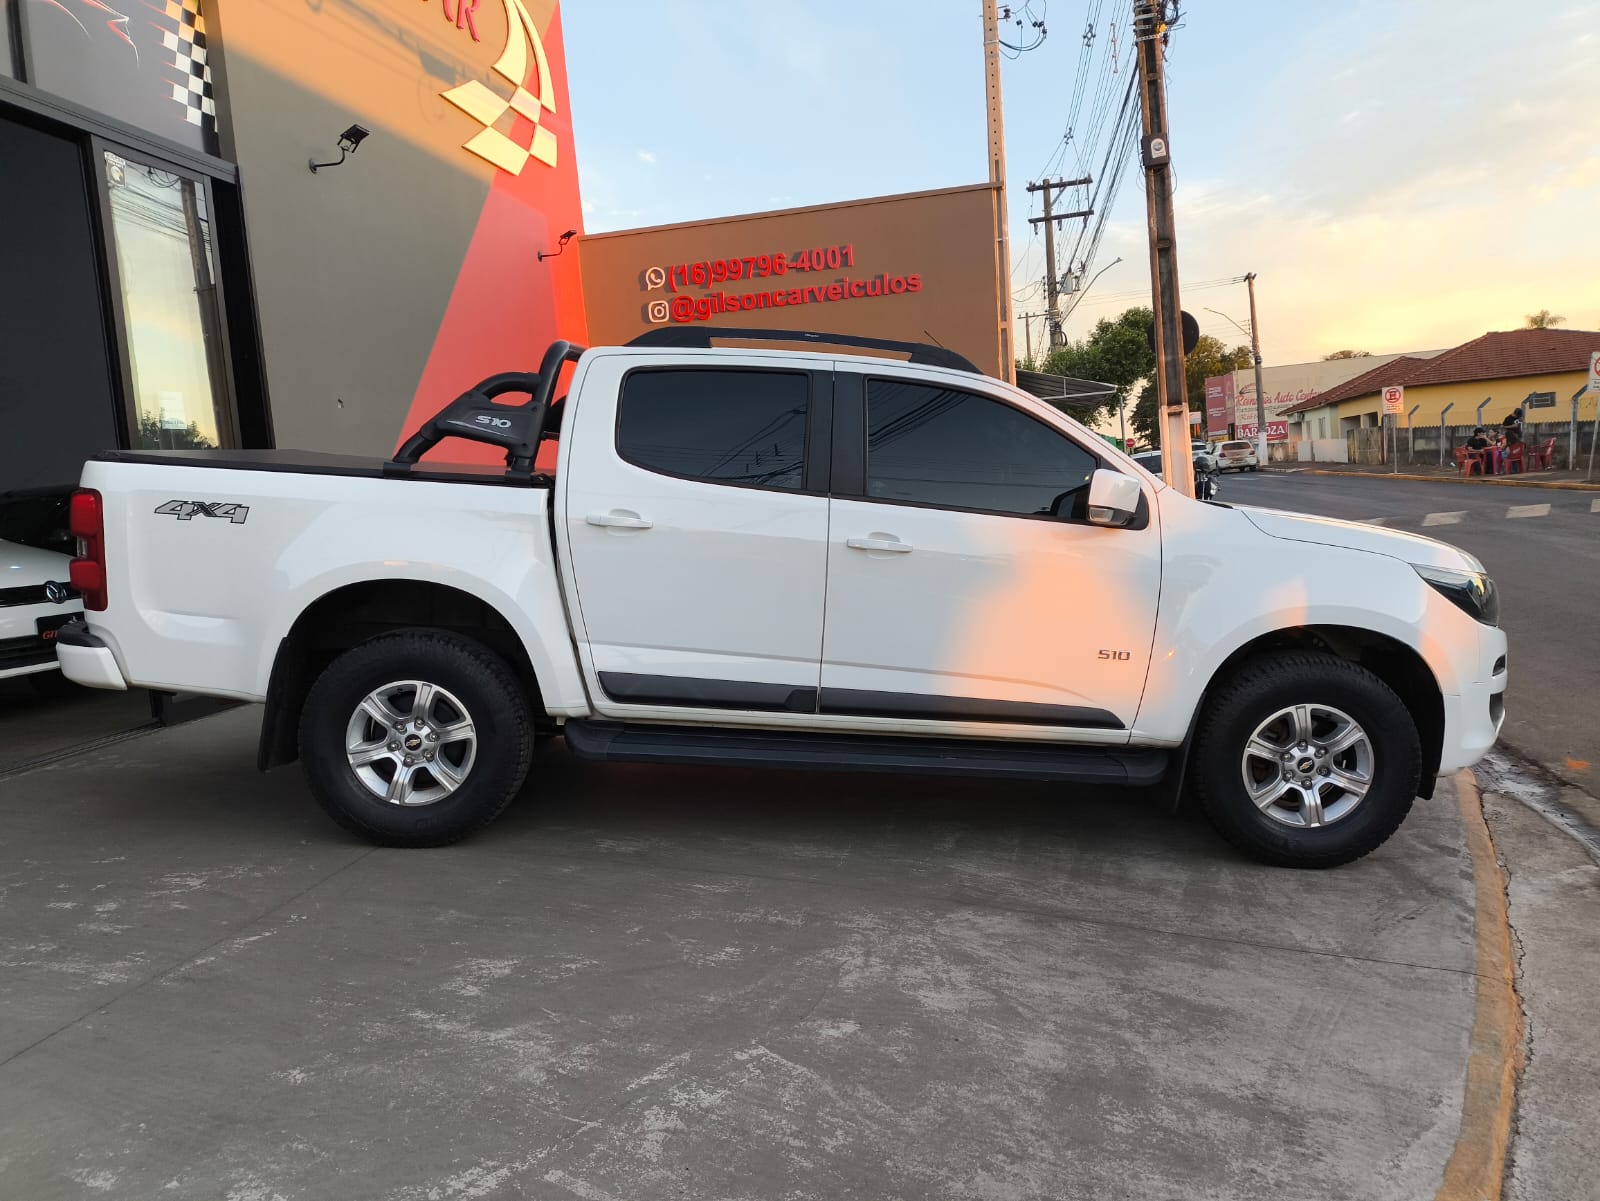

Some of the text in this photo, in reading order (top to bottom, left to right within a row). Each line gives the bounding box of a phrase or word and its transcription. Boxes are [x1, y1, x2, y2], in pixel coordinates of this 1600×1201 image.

[668, 244, 855, 292] (16)99796-4001
[671, 273, 923, 322] @gilsoncarveiculos
[1274, 391, 1294, 404] Auto
[1296, 388, 1321, 402] Cent
[475, 415, 512, 428] S10
[1237, 425, 1286, 439] BAROZA
[1097, 649, 1131, 661] S10
